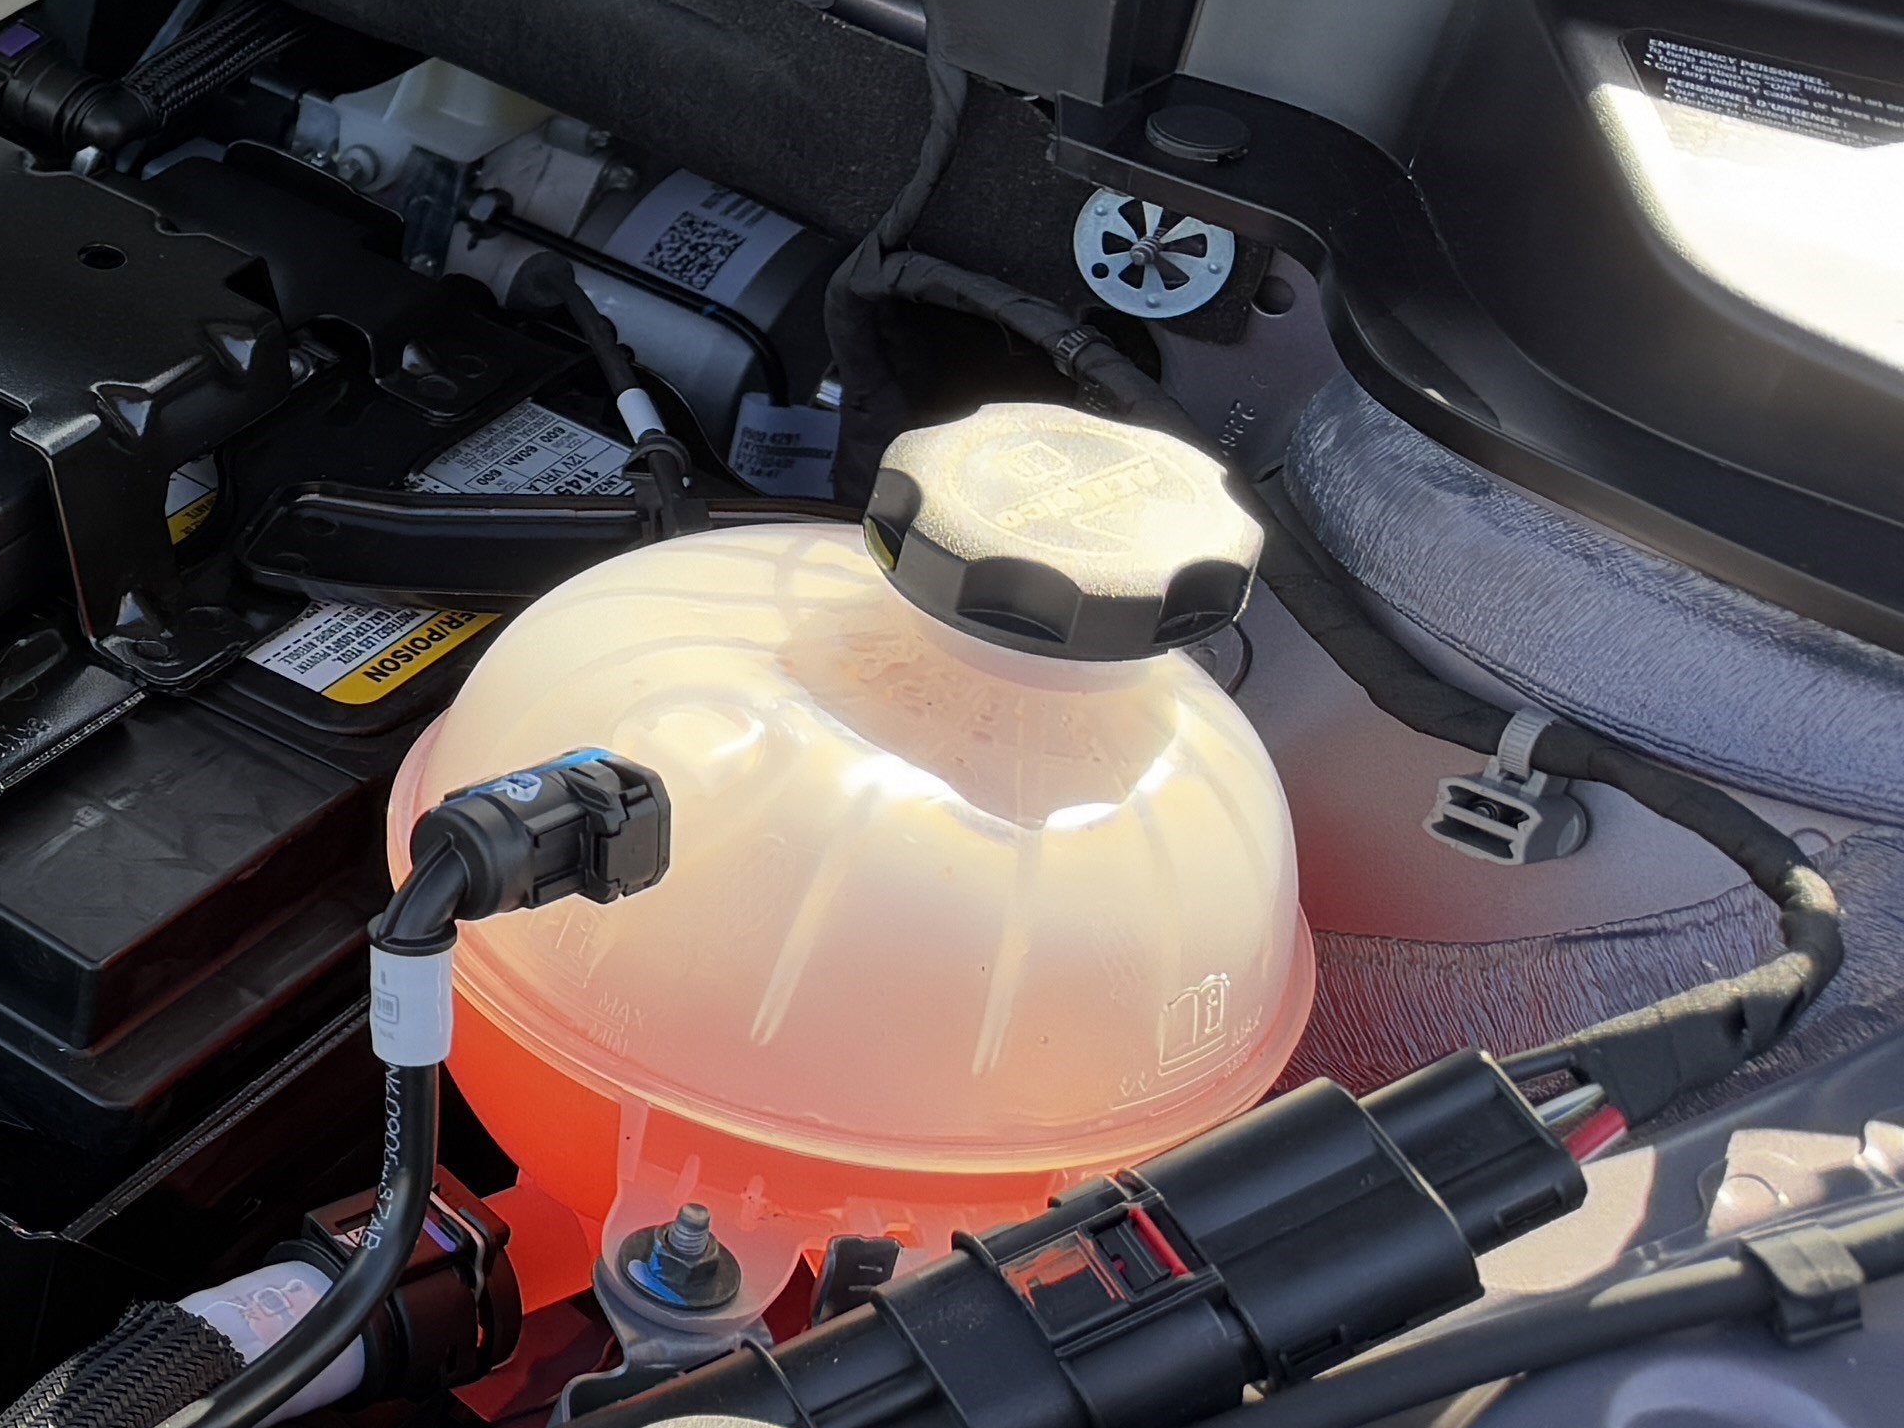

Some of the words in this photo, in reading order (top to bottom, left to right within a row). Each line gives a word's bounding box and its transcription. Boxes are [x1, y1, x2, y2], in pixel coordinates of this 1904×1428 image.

[1648, 45, 1661, 54] To
[1666, 50, 1695, 63] help
[1699, 58, 1735, 72] avoid
[1740, 68, 1800, 88] personal
[1804, 83, 1843, 99] injury
[1649, 37, 1736, 65] EMERGENCY
[1741, 59, 1829, 87] PERSONNEL:
[1659, 55, 1686, 67] Turn
[1691, 63, 1741, 81] ignition
[1655, 62, 1677, 73] Cut
[1710, 75, 1758, 93] battery
[1763, 88, 1808, 105] cables
[1667, 77, 1751, 104] PERSONNEL
[556, 451, 589, 470] 12V
[520, 466, 568, 494] VRLA
